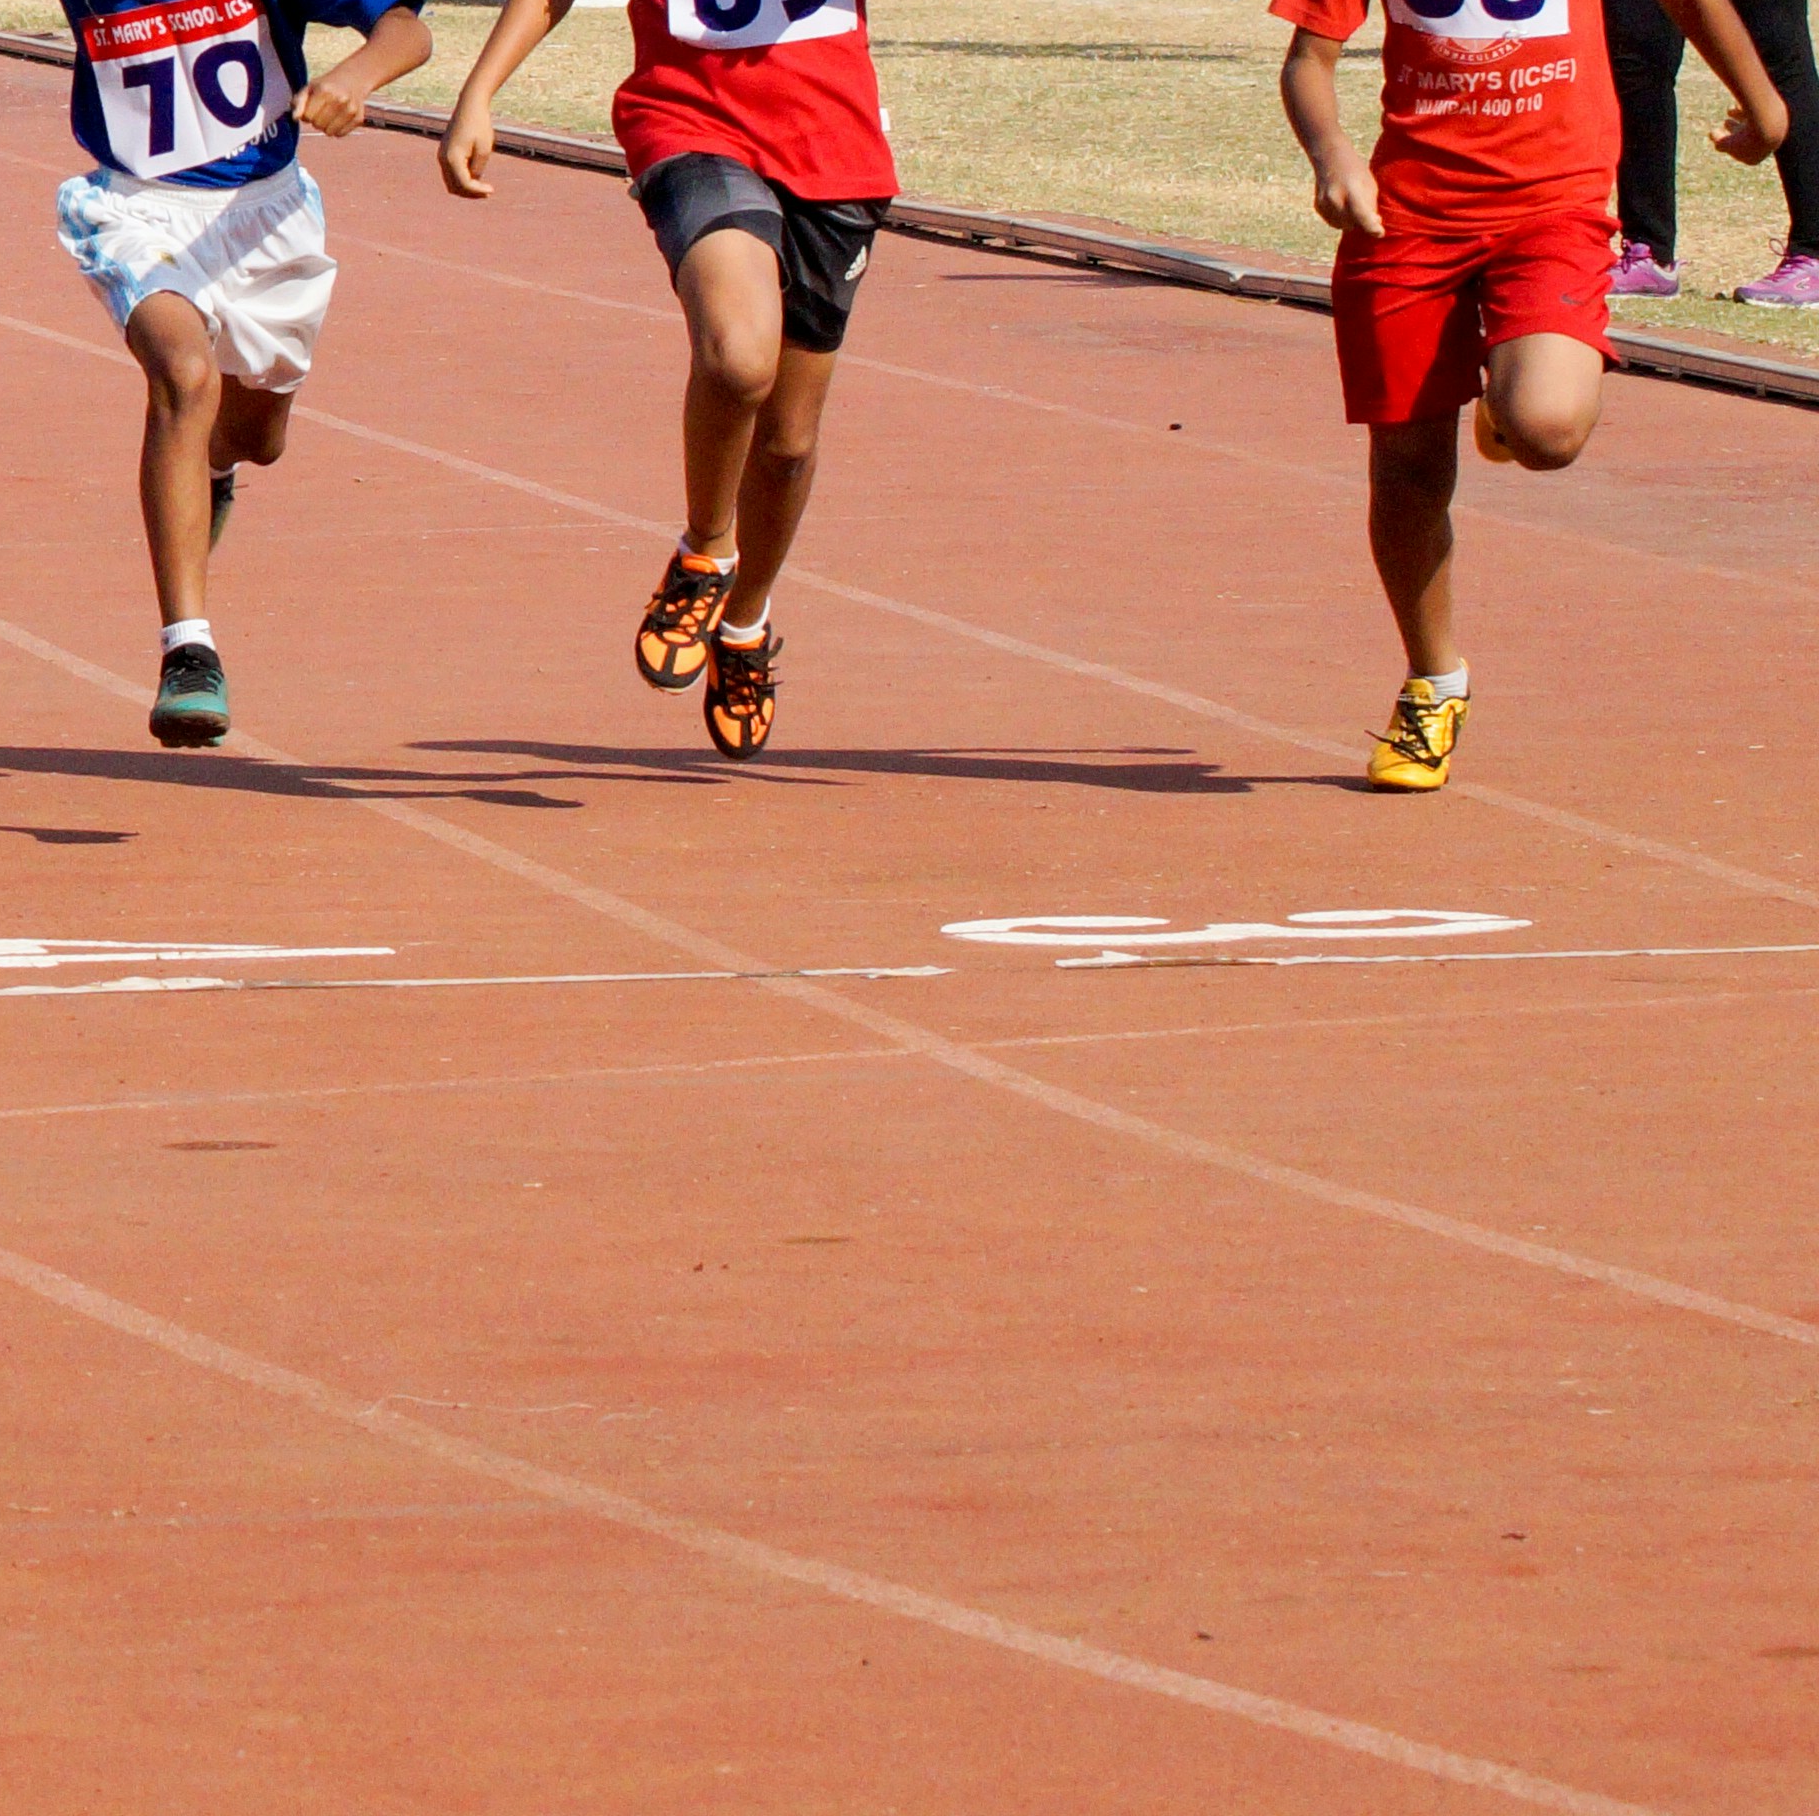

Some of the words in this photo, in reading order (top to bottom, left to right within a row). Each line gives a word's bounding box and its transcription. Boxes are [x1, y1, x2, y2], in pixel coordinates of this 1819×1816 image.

[93, 29, 111, 46] ST.
[112, 16, 166, 45] MARY'S
[167, 5, 223, 31] SCHOOL
[1417, 70, 1502, 93] MARY'S
[1510, 58, 1577, 93] (ICSE)
[122, 40, 264, 158] 70
[1481, 98, 1513, 117] 400
[1515, 93, 1543, 114] 010
